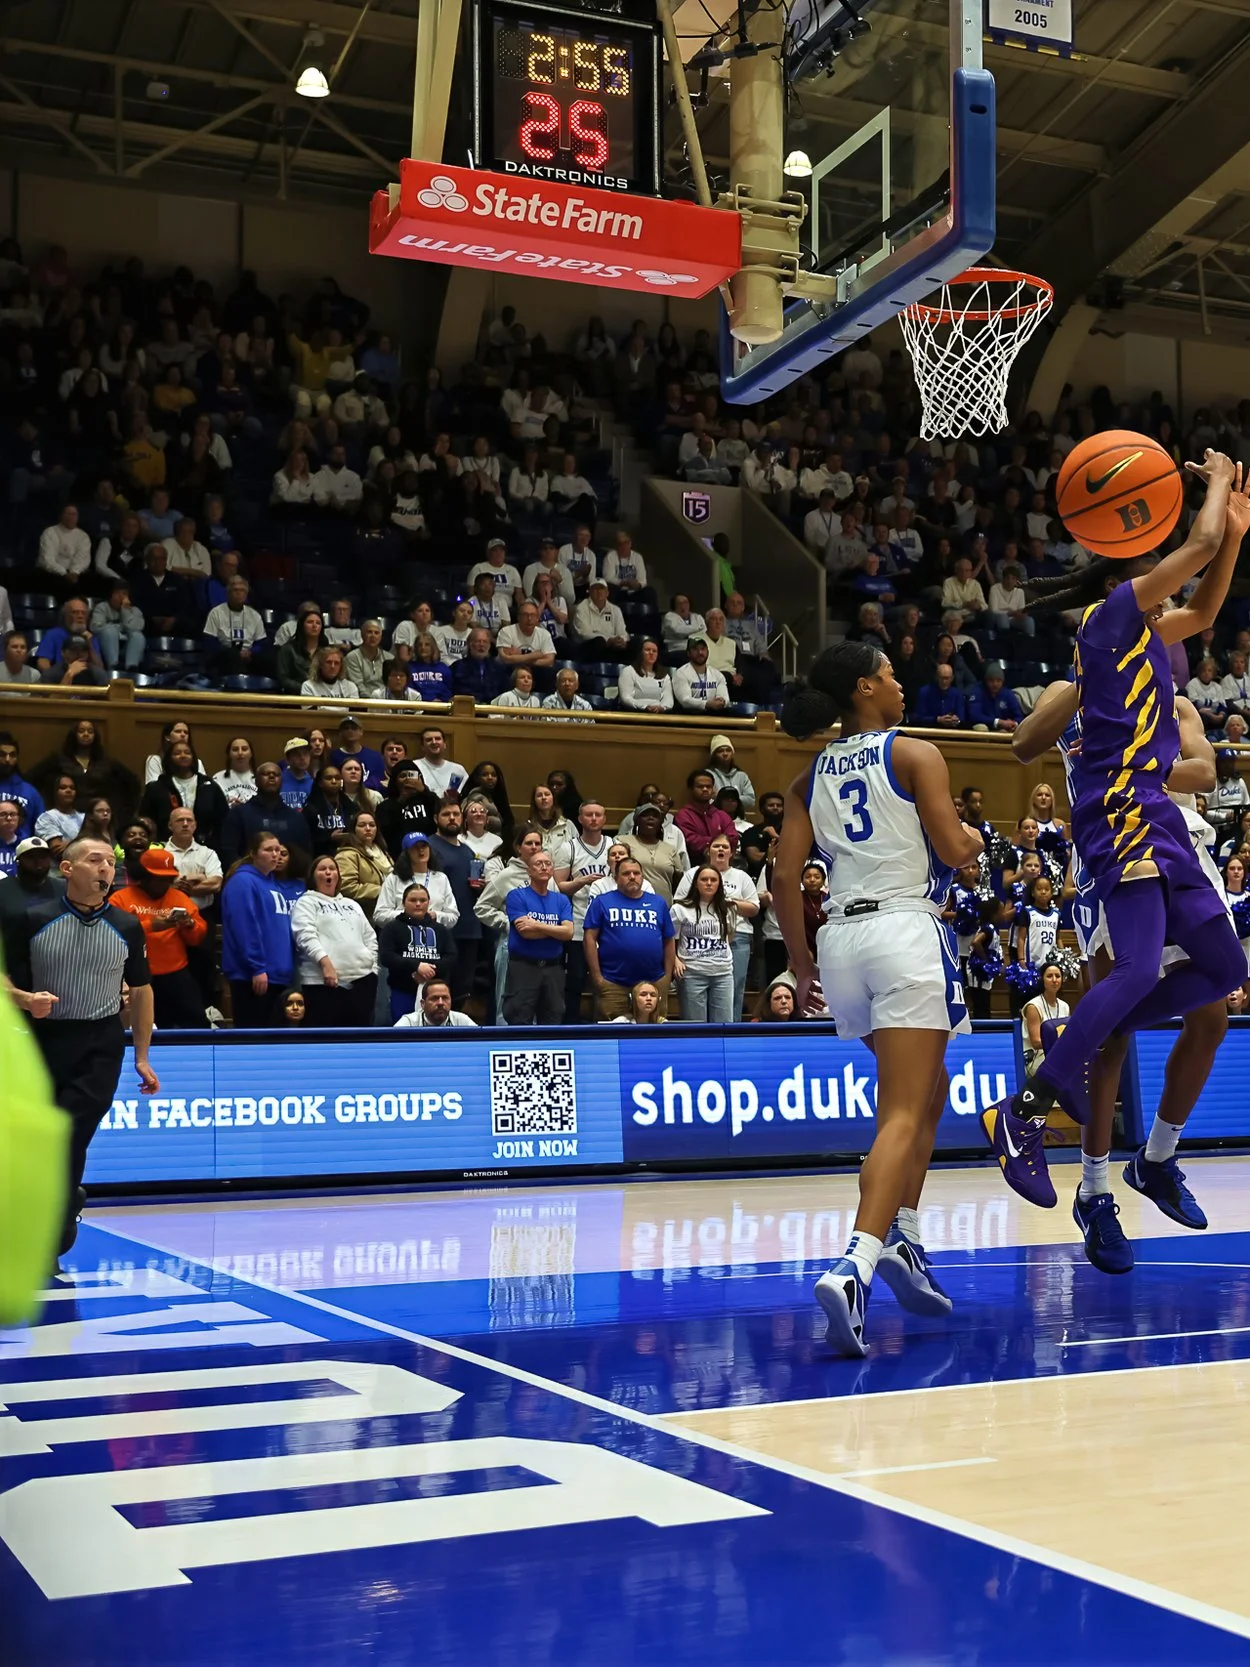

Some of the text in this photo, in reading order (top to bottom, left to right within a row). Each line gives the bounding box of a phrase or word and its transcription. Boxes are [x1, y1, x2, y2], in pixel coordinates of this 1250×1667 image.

[1014, 9, 1047, 28] 2005
[527, 33, 630, 96] 2:55
[520, 93, 609, 168] 25
[505, 161, 628, 189] DAKTRONICS
[688, 500, 706, 518] 15
[818, 745, 881, 776] JACKSON
[838, 778, 874, 843] 3
[579, 865, 611, 877] DUK
[538, 912, 545, 920] TO
[546, 913, 559, 921] HELL
[609, 908, 658, 925] DUKE
[1036, 920, 1057, 928] DUKE
[1040, 931, 1054, 945] 26
[148, 1096, 326, 1128] FACEBOOK
[334, 1093, 463, 1123] GROUPS
[492, 1139, 579, 1159] JOIN NOW
[463, 1170, 508, 1178] DAKTRONICS
